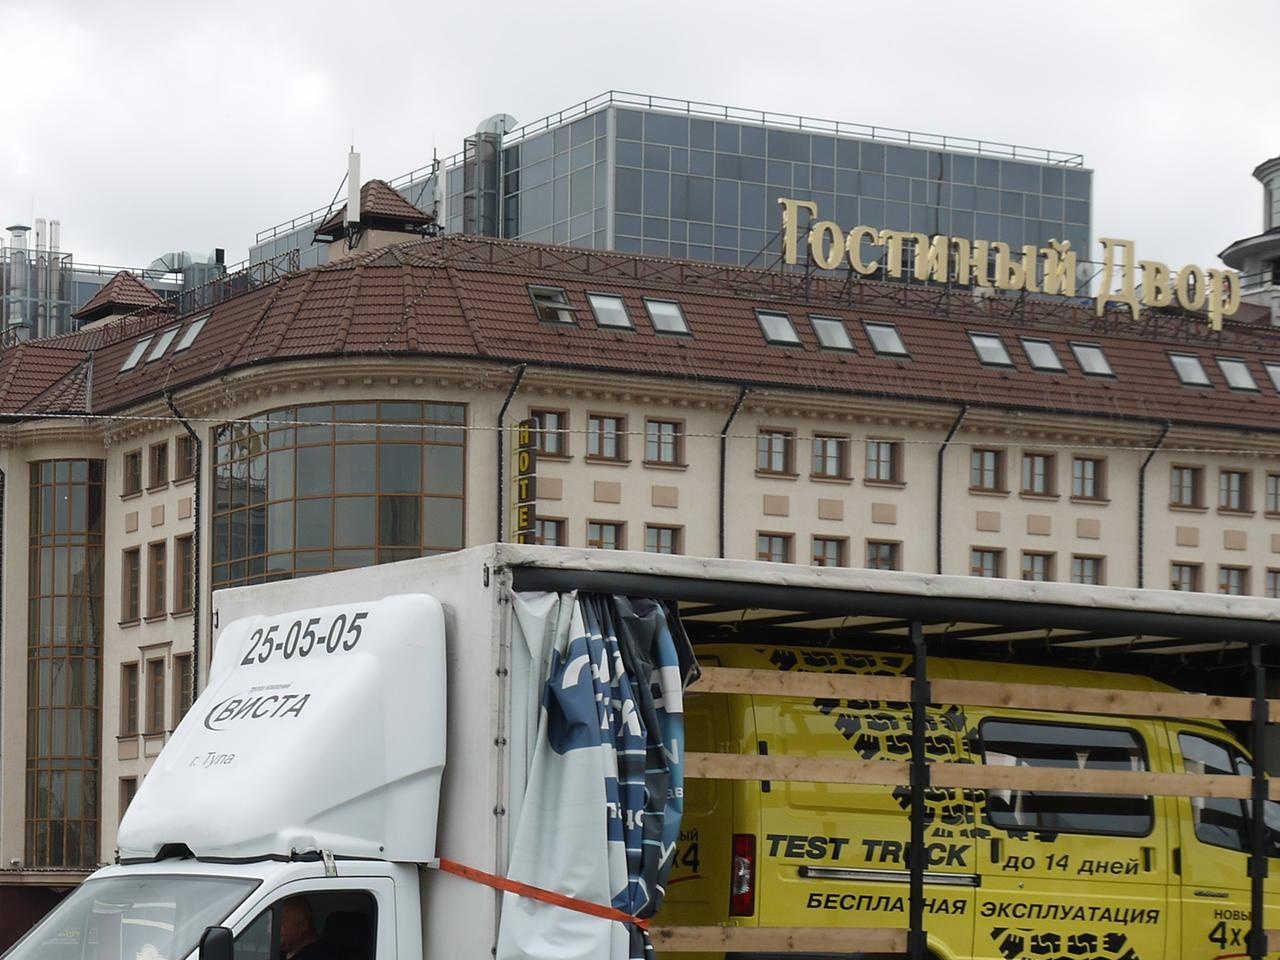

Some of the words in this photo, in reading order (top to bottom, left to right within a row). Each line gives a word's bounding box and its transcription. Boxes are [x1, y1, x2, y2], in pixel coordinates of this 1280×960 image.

[778, 198, 1077, 297] Гостиный
[1096, 237, 1240, 331] Двор
[241, 612, 368, 666] 25-05-05
[204, 751, 236, 769] Тула
[766, 834, 849, 860] TEST
[862, 839, 972, 867] TRCK
[1002, 855, 1035, 871] до
[1046, 853, 1069, 871] 14
[1077, 857, 1141, 876] дней
[806, 893, 967, 915] БЕСПЛАНАЯ
[980, 901, 1160, 925] ЭКСПЛУАТАЦИЯ
